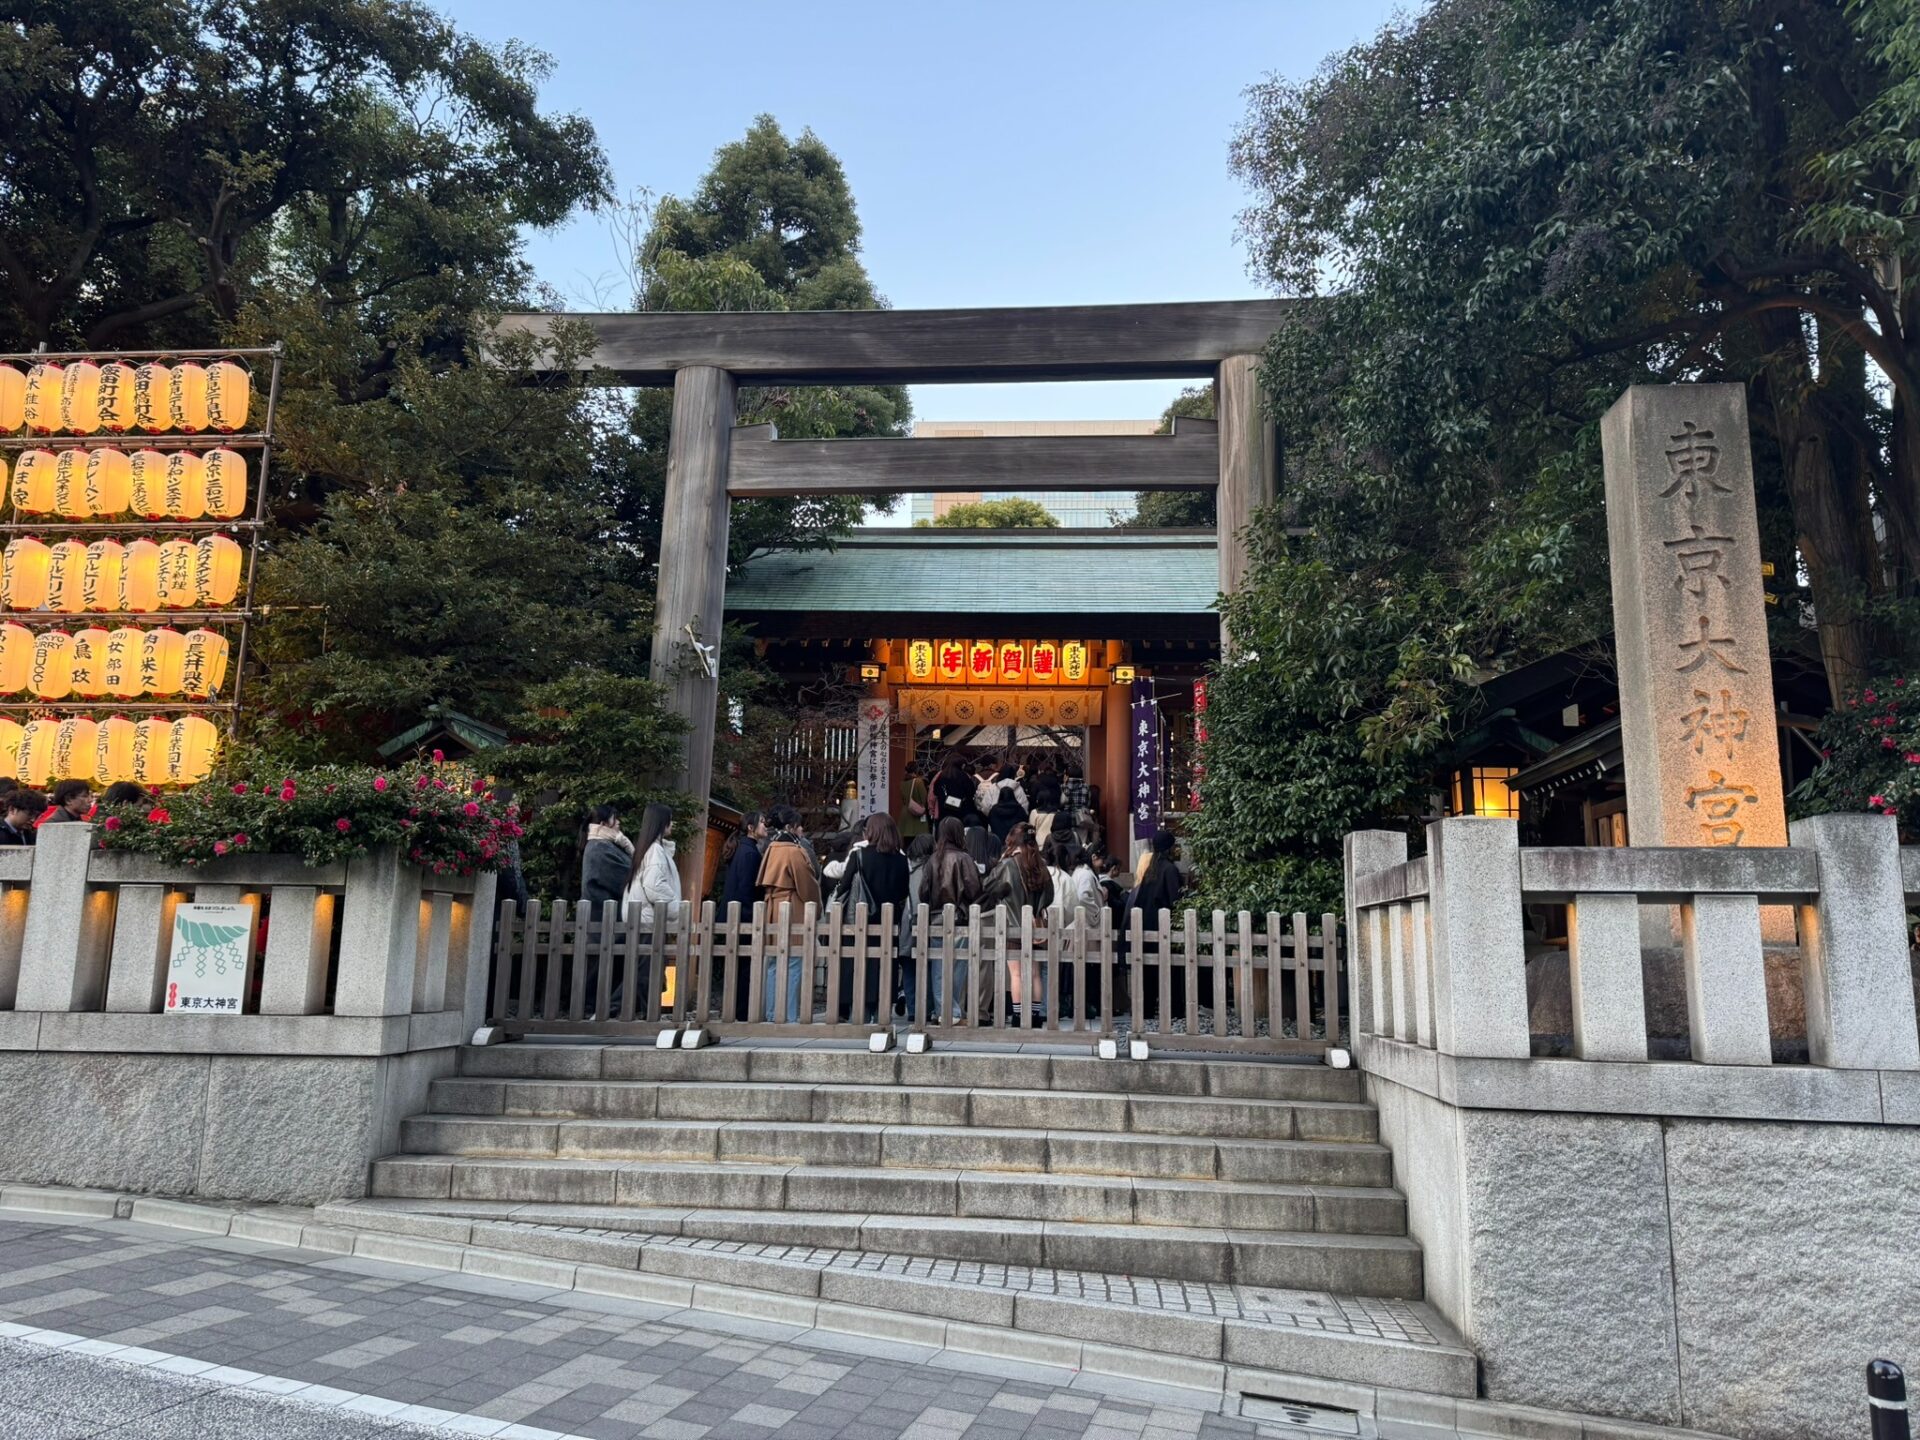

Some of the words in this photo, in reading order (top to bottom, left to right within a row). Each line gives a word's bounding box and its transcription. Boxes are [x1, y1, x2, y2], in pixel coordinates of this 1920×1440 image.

[98, 365, 121, 422] 飯田町町会
[13, 455, 35, 506] はま家
[1657, 420, 1758, 847] 東京大神宮
[72, 638, 92, 684] 鳥政
[1137, 720, 1150, 820] 東京大神宮
[180, 997, 238, 1009] 東京大神宮
